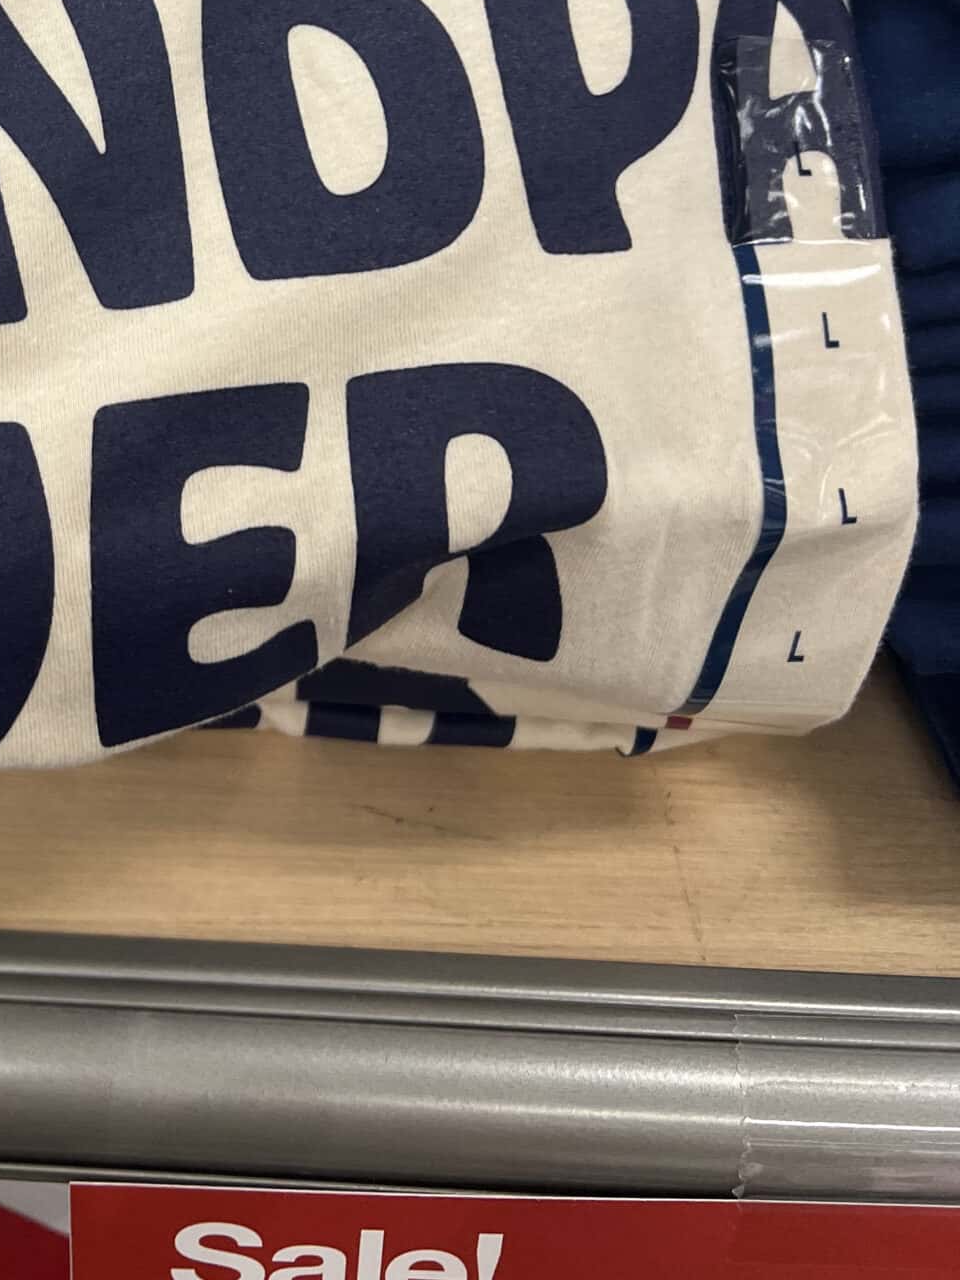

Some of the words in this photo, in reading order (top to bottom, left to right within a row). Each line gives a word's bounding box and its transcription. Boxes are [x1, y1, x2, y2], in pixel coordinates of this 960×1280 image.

[793, 140, 813, 177] L
[821, 312, 840, 349] L
[838, 487, 858, 524] L
[786, 630, 806, 663] L
